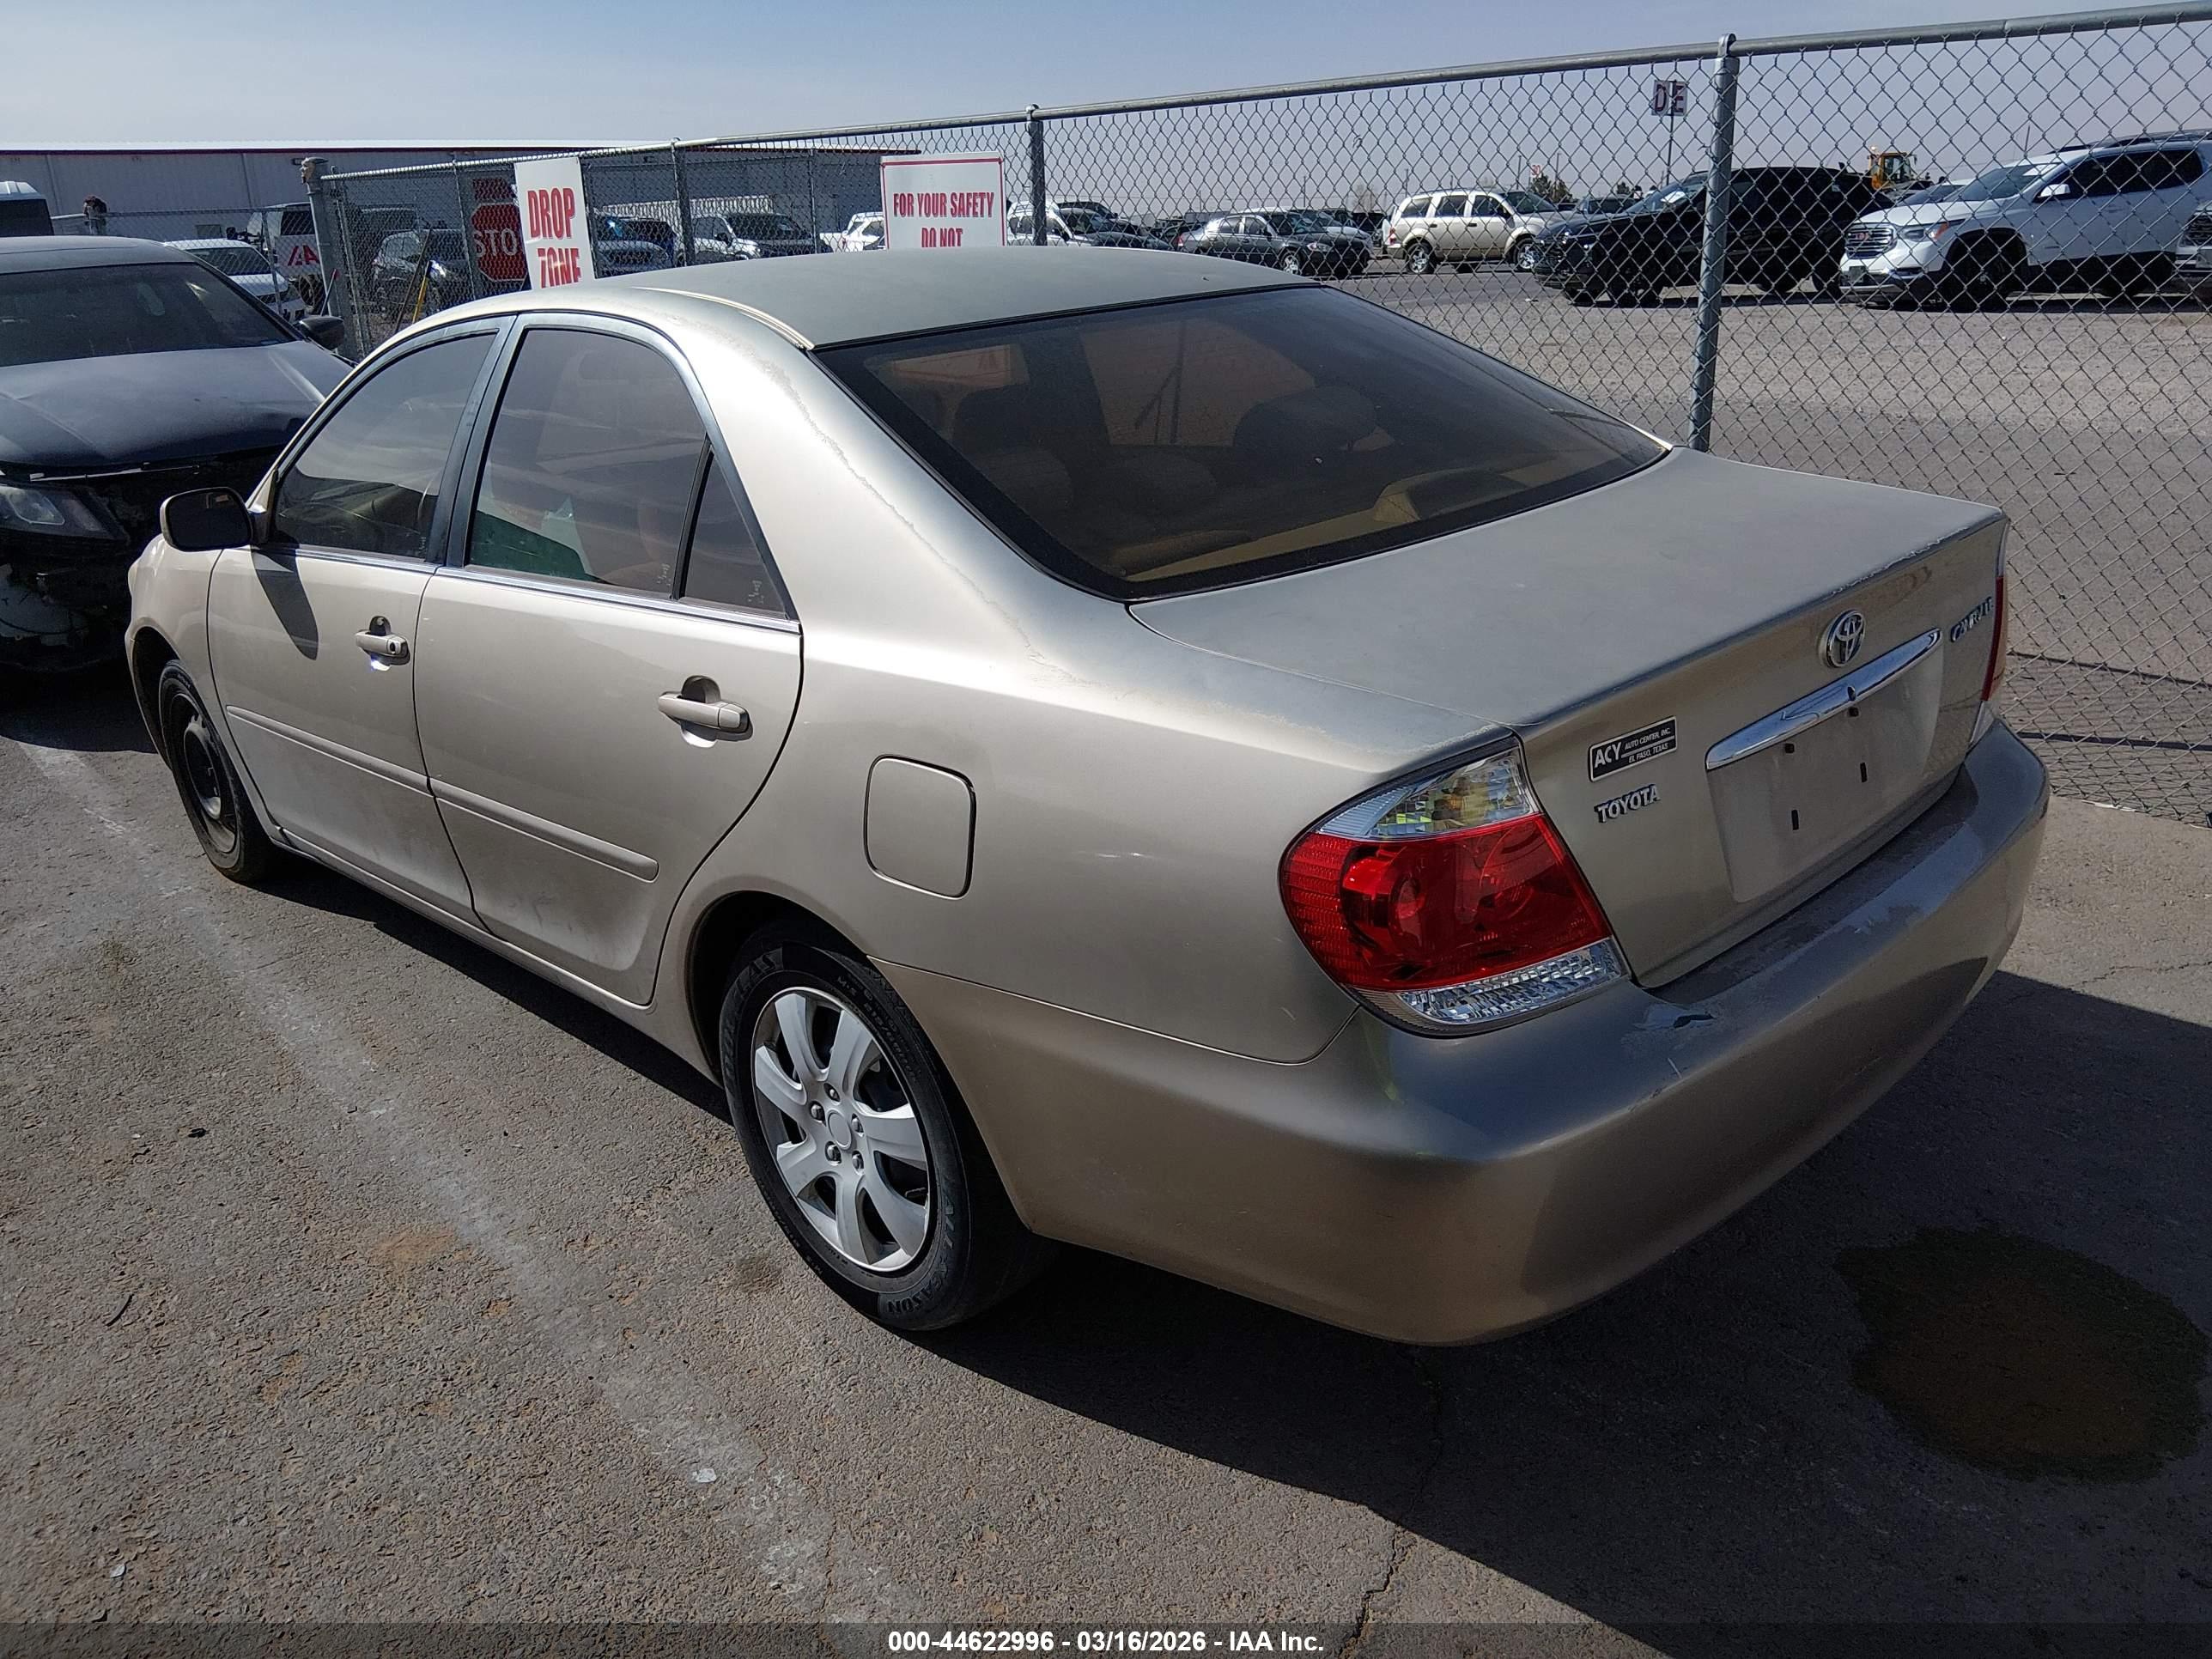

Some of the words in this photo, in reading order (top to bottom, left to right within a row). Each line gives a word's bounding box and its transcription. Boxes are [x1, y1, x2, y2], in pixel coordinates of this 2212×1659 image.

[527, 187, 576, 240] DROP
[893, 192, 915, 217] FOR
[917, 192, 947, 217] YOUR
[951, 191, 995, 217] SAFETY
[473, 228, 518, 258] STO
[921, 227, 937, 247] DO
[939, 227, 963, 247] NOT
[1594, 740, 1622, 769] ACY
[1625, 739, 1639, 750] AUTO
[1628, 755, 1636, 763] EL
[1652, 742, 1669, 754] TEXAS
[1595, 783, 1661, 823] TOYOTA
